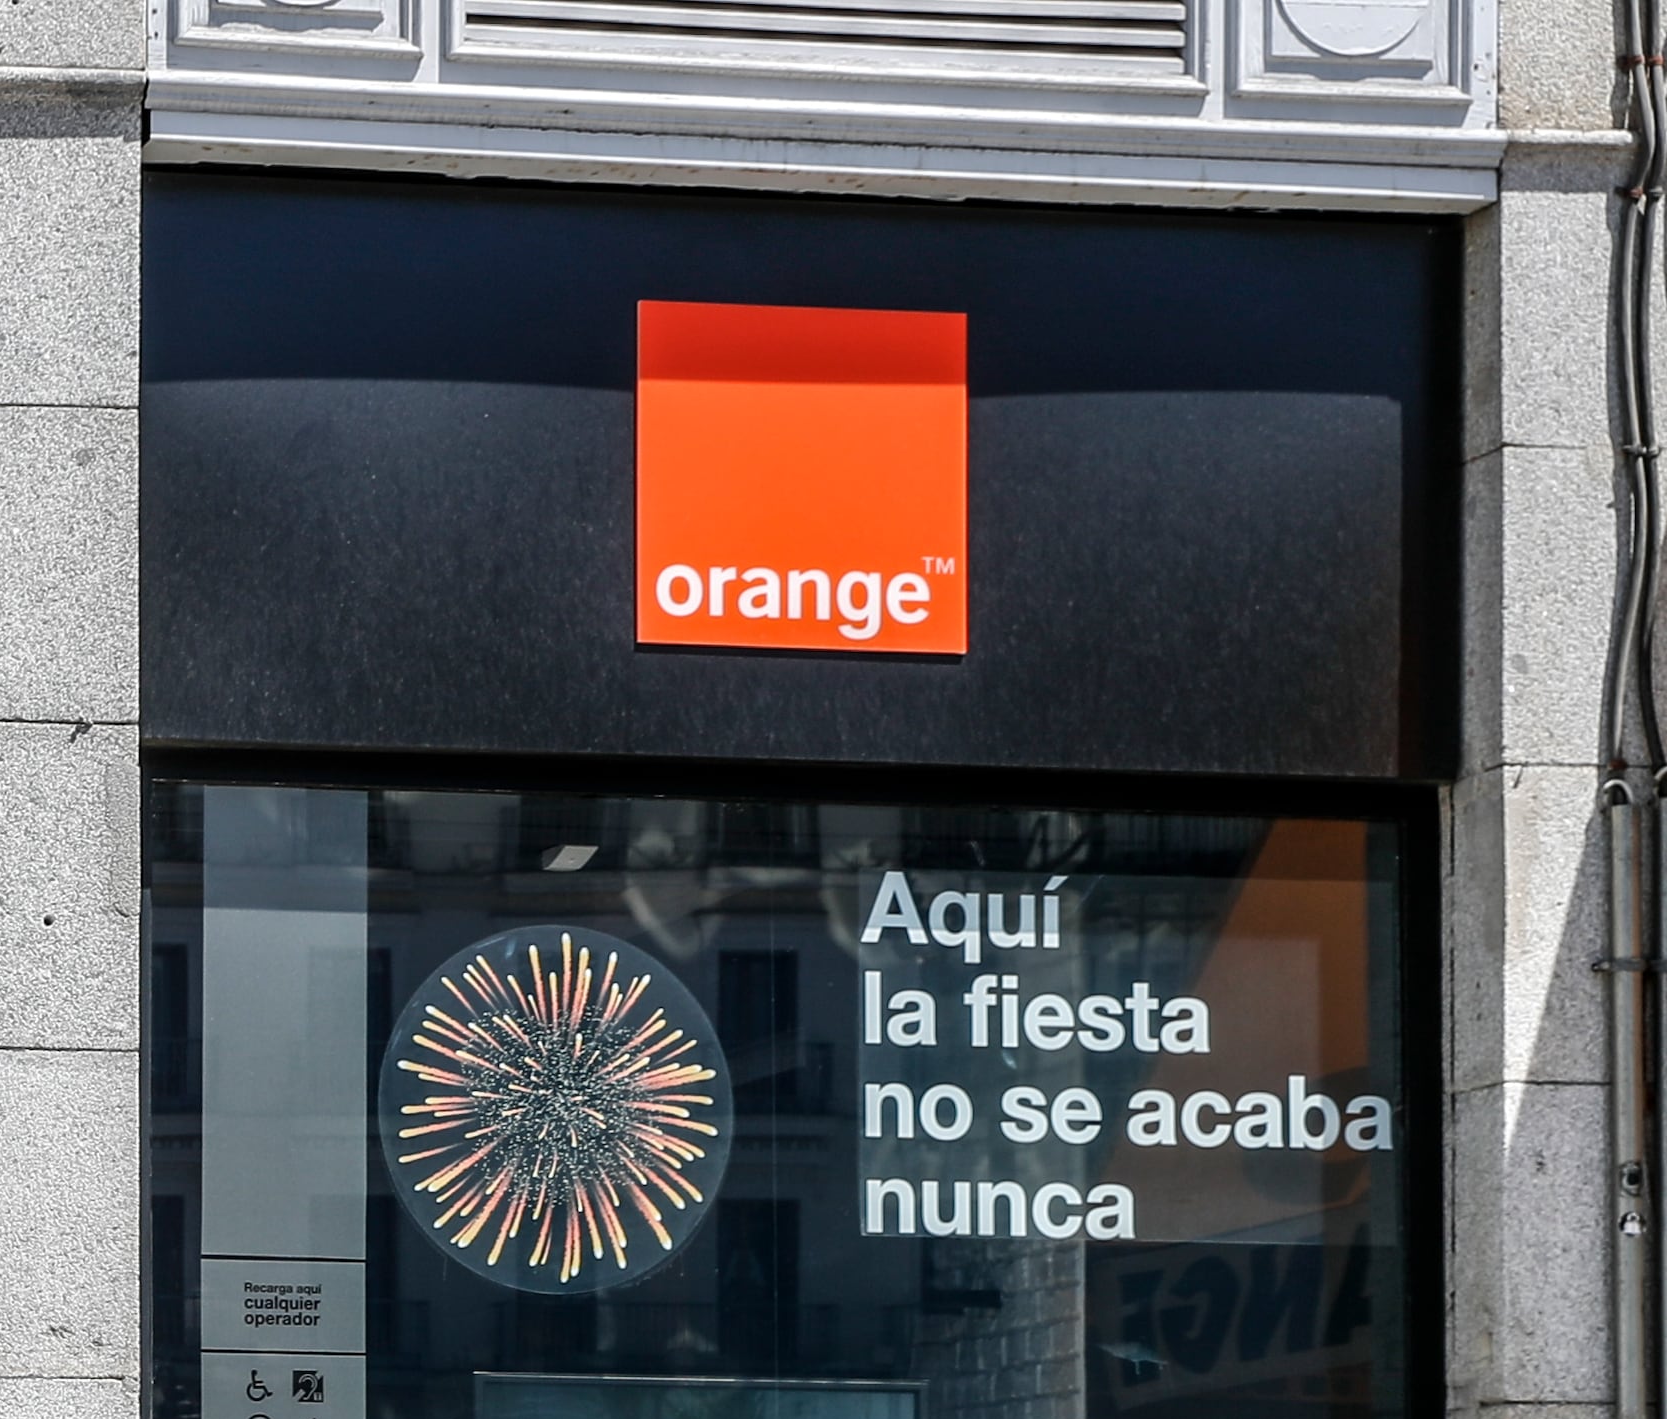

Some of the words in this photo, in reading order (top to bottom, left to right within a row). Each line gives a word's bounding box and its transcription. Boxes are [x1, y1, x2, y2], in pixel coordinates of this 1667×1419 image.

[656, 564, 930, 639] orange
[861, 871, 1068, 964] Aquí
[865, 971, 937, 1046] la
[965, 975, 1210, 1054] fiesta
[865, 1082, 973, 1140] no
[1000, 1084, 1103, 1144] se
[1127, 1075, 1393, 1150] acaba
[867, 1178, 1135, 1239] nunca
[245, 1283, 293, 1295] Recarga
[297, 1284, 321, 1294] aquí
[245, 1296, 320, 1312] cualquier
[245, 1312, 319, 1327] operador
